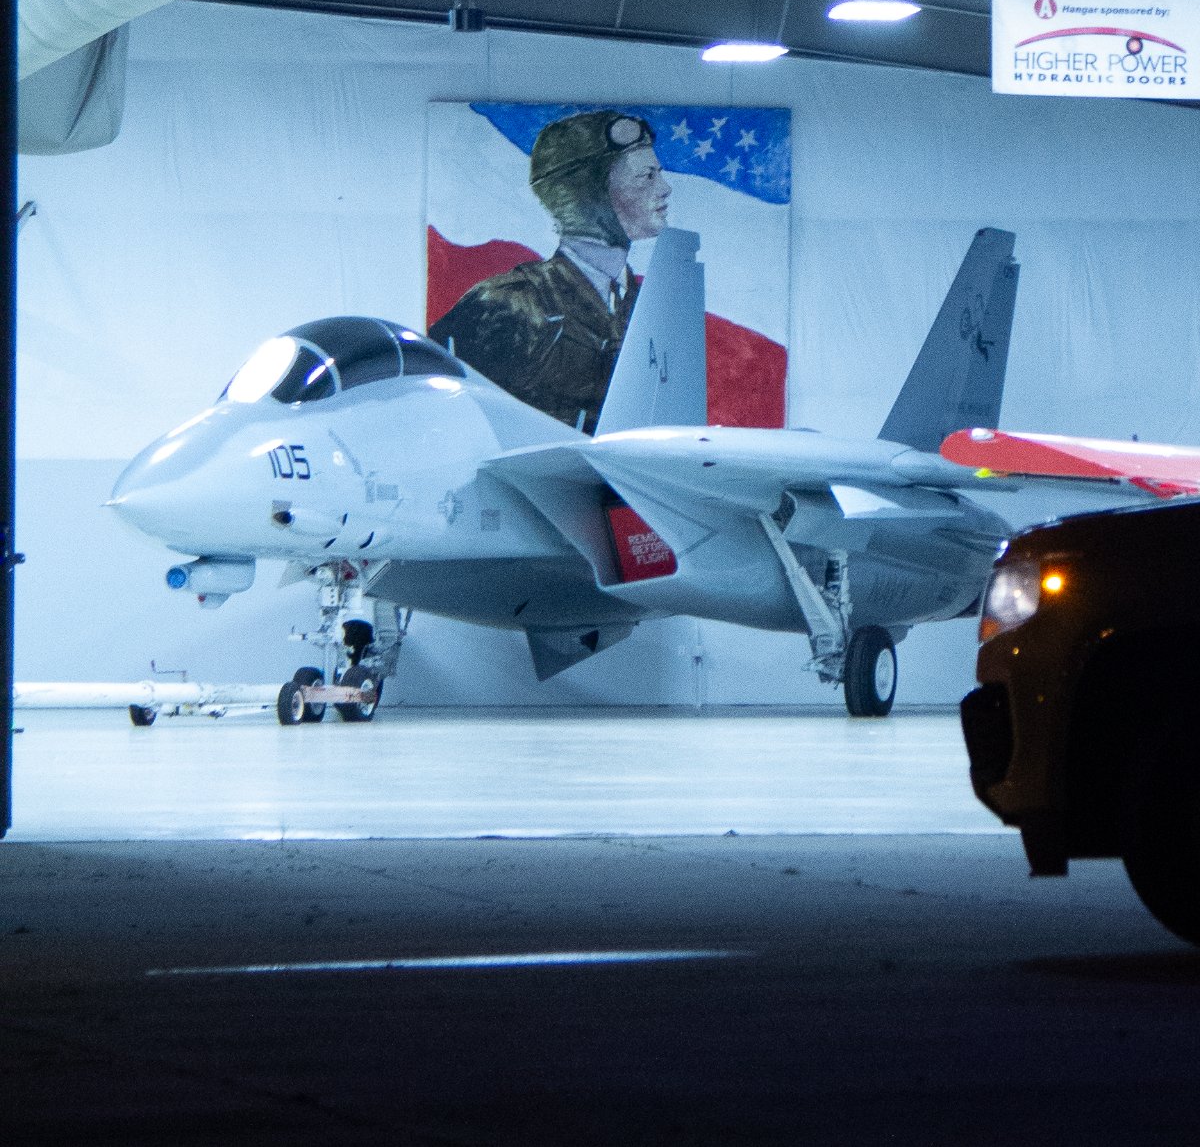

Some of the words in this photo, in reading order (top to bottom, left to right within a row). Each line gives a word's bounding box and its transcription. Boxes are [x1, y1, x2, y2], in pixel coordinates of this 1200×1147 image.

[1062, 5, 1098, 15] Hangar
[1101, 5, 1153, 15] sponsored
[1155, 6, 1171, 16] by:
[1014, 51, 1098, 71] HIGHER
[1108, 52, 1187, 74] POWER
[1014, 72, 1114, 83] HYDRAULIC
[1126, 75, 1187, 86] DOORS
[649, 337, 668, 383] AJ
[267, 444, 310, 479] 105
[628, 532, 659, 545] REMO
[636, 551, 670, 565] FLIGHT
